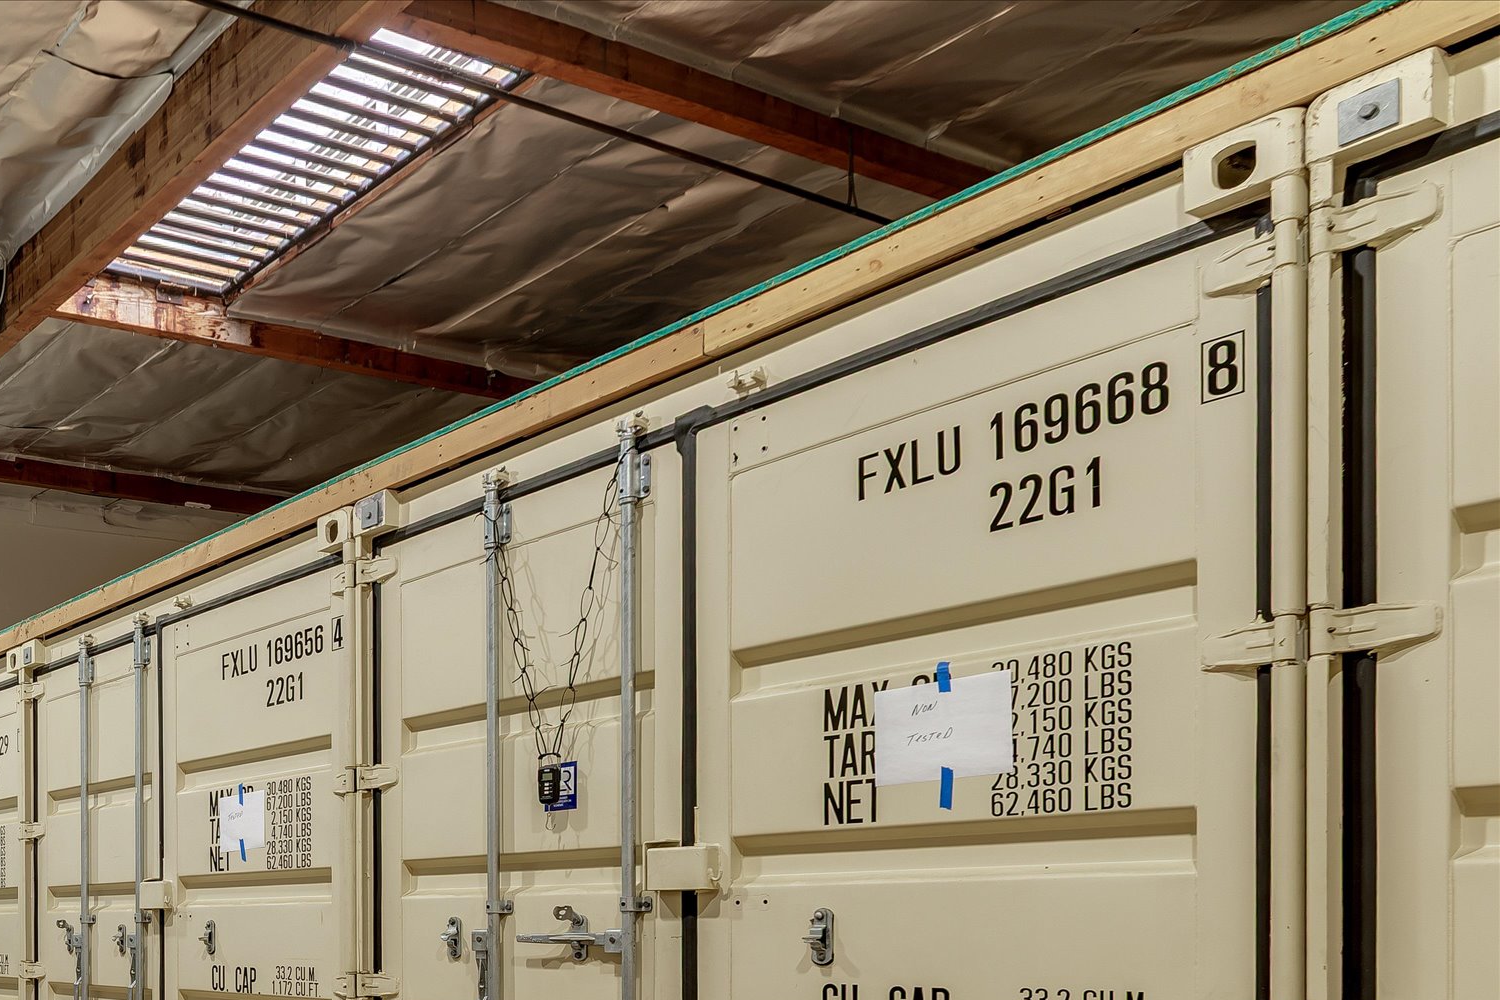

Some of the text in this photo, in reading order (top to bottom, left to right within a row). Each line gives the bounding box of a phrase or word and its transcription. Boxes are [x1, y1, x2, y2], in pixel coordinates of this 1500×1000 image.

[857, 339, 1238, 501] FXLU 169668 8
[989, 456, 1102, 533] 22G1
[222, 617, 343, 680] FXLU 169656 4
[1084, 641, 1133, 673] KGS
[266, 671, 303, 708] 22G1
[1010, 669, 1133, 712] 7,200 LBS
[911, 699, 938, 717] NON
[1084, 697, 1133, 730] KGS
[823, 732, 876, 779] TAR
[1084, 725, 1133, 756] LBS
[1084, 754, 1133, 784] KGS
[296, 776, 312, 793] KGS
[296, 791, 312, 808] LBS
[991, 782, 1133, 817] 62,460 LBS
[296, 807, 312, 823] KGS
[296, 822, 312, 838] LBS
[296, 837, 312, 853] KGS
[296, 852, 312, 869] LBS
[211, 965, 228, 992] CU.
[275, 965, 317, 982] 33.2 CU.M.
[271, 980, 321, 998] 1,172 CU.FT.
